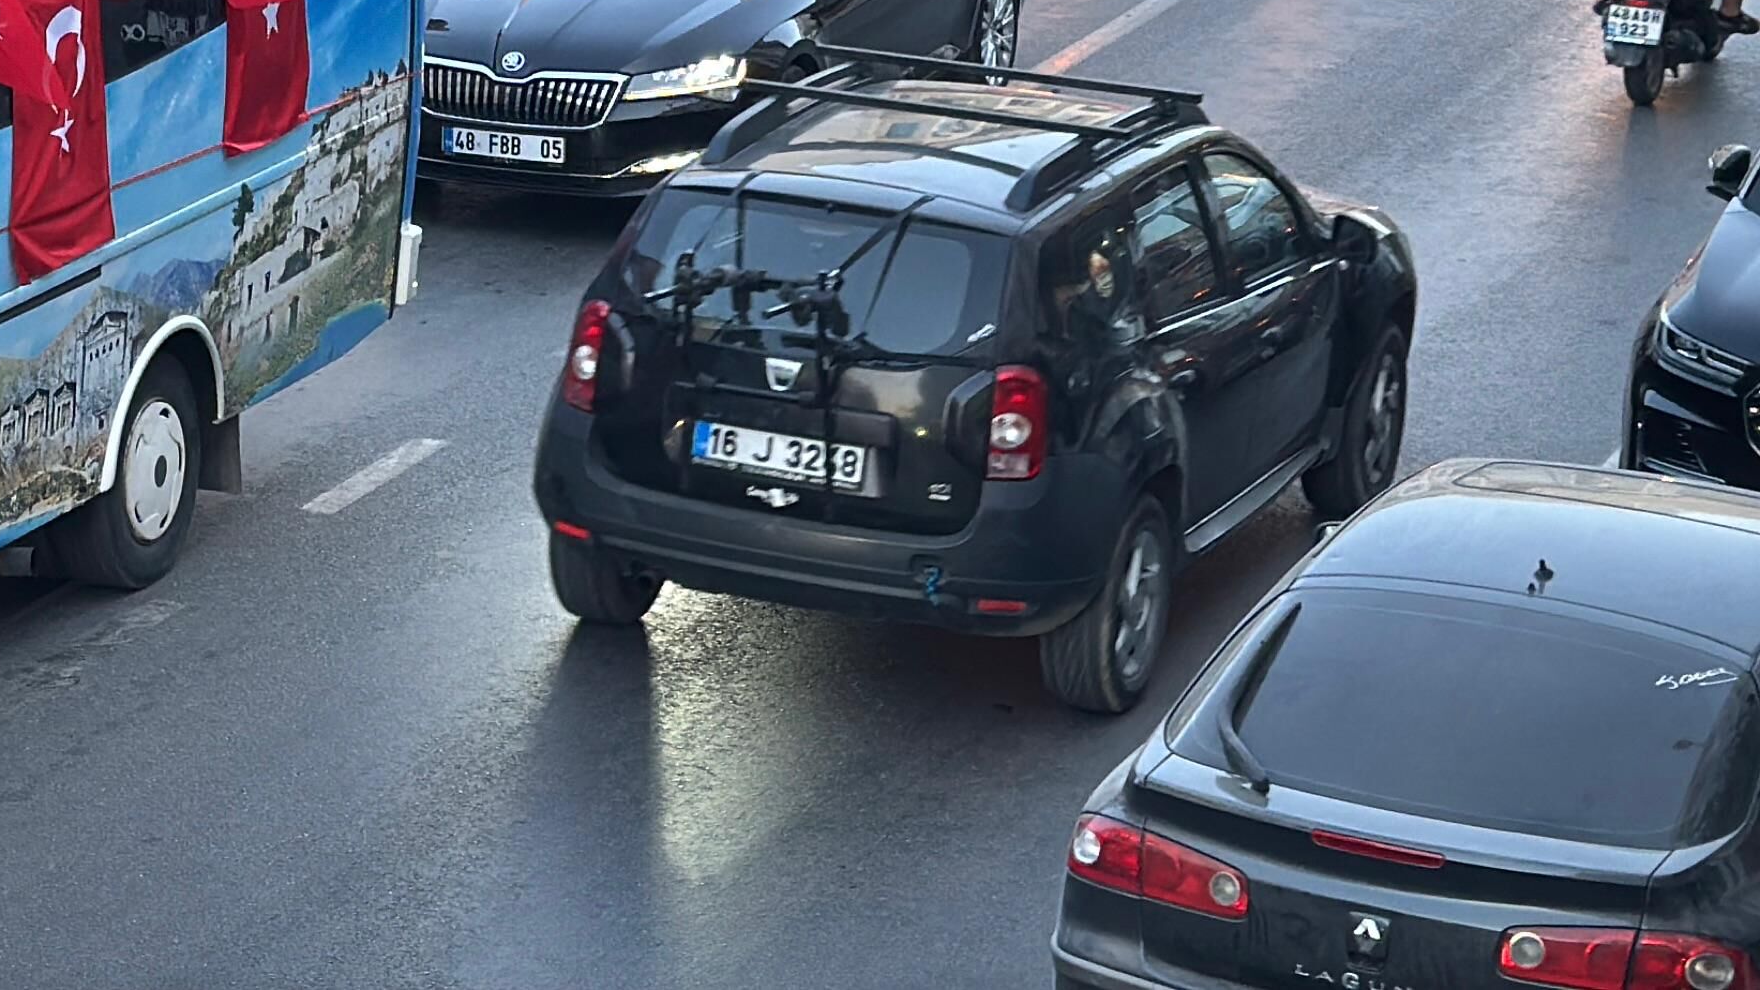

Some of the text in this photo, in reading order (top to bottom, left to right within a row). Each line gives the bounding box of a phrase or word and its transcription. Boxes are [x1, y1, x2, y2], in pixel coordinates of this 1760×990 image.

[455, 131, 561, 160] 48 FBB 05
[711, 428, 737, 457] 16
[752, 436, 774, 462] J
[1294, 963, 1414, 990] LAGU
